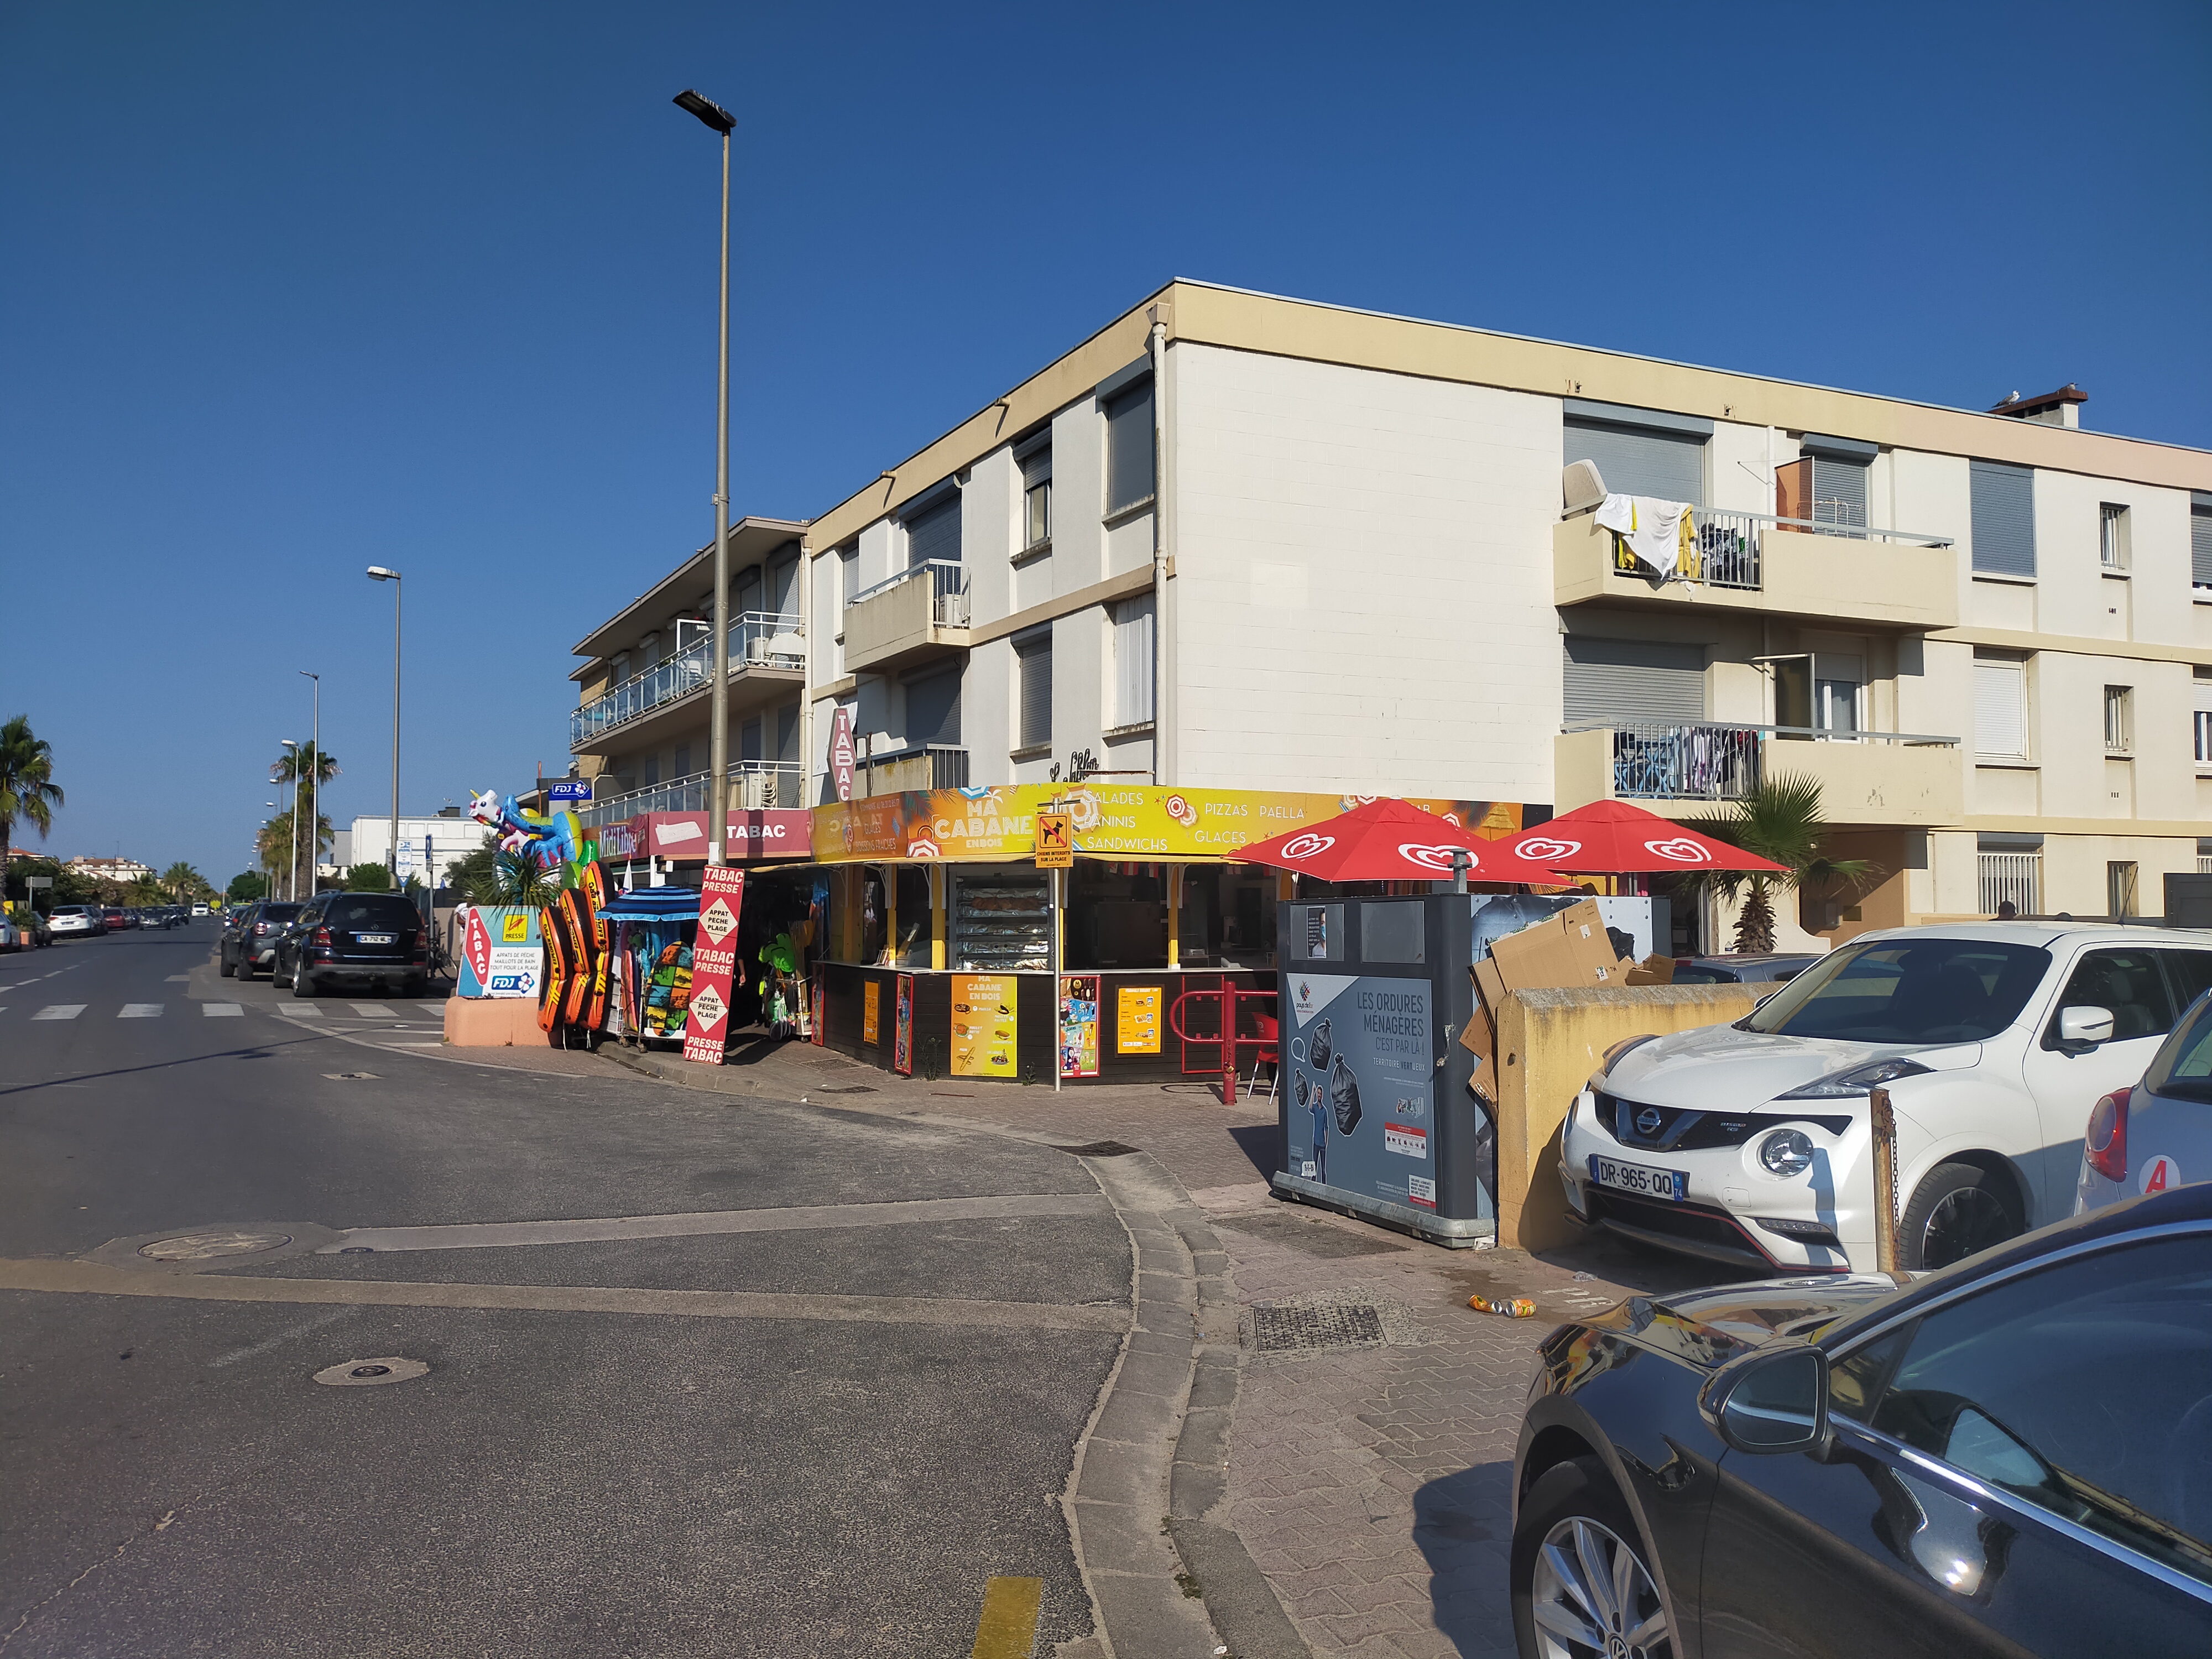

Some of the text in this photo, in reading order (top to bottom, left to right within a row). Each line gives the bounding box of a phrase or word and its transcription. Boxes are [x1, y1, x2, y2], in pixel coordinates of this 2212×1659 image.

[835, 715, 854, 801] TABAC
[1085, 791, 1144, 805] SALADES
[967, 800, 998, 817] MA
[1205, 804, 1248, 816] PIZZAS
[1260, 805, 1304, 818] PAELLA
[864, 822, 881, 834] GLACES
[935, 815, 1033, 839] CABANE
[1084, 815, 1136, 828] PANINIS
[726, 824, 786, 839] TABAC
[1194, 830, 1246, 843] GLACES
[599, 826, 637, 858] Midi Libre
[855, 839, 875, 852] BOISSONS
[1087, 837, 1168, 851] SANDWICHS
[704, 867, 744, 883] TABAC
[702, 881, 739, 894] PRESSE
[471, 918, 486, 974] TABAC
[696, 948, 734, 964] TABAC
[695, 962, 732, 975] PRESSE
[493, 978, 515, 988] FDJ
[1357, 992, 1423, 1014] LES ORDURES
[1364, 1010, 1424, 1037] MÉNAGÈRES
[687, 1036, 724, 1051] PRESSE
[1376, 1036, 1394, 1051] C'EST
[1396, 1039, 1409, 1053] PAR
[1411, 1038, 1420, 1055] LÀ
[684, 1046, 723, 1064] TABAC
[1373, 1057, 1425, 1072] TERRITOIRE VERTUEUX
[1600, 1162, 1672, 1195] DR-965-QQ
[1674, 1188, 1682, 1198] 74
[2145, 1160, 2167, 1194] A
